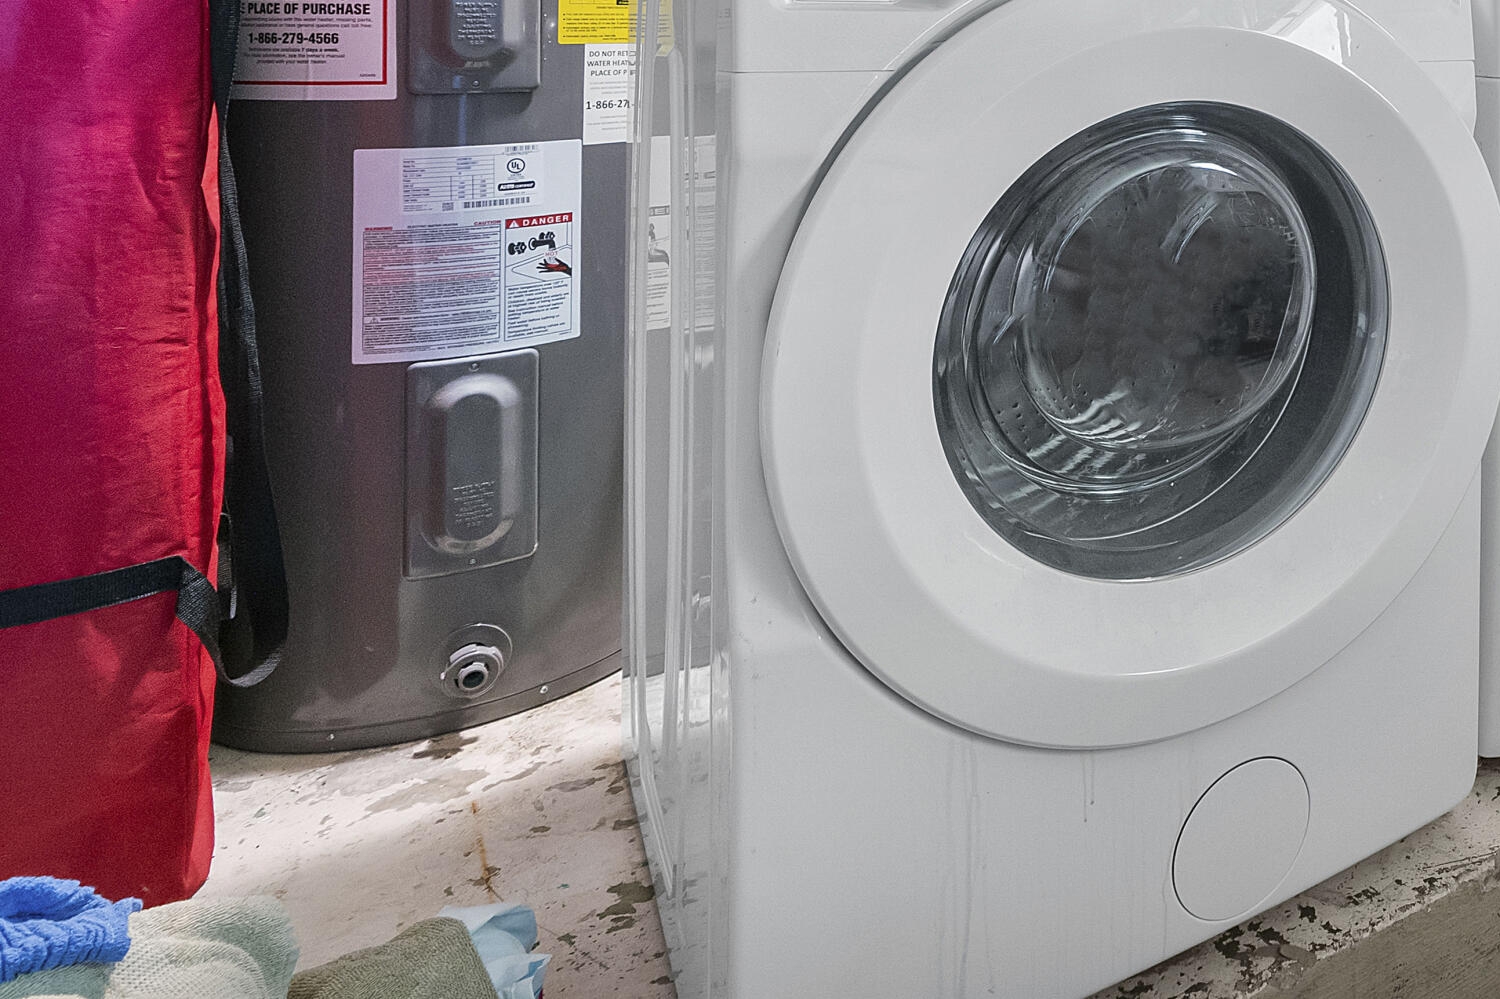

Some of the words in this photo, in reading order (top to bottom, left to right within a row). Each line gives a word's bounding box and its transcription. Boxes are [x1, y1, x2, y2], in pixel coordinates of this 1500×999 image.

[247, 3, 281, 15] PLACE
[284, 3, 299, 15] OF
[302, 3, 371, 15] PURCHASE
[248, 32, 339, 44] 1-866-279-4566
[522, 213, 569, 227] DANGER
